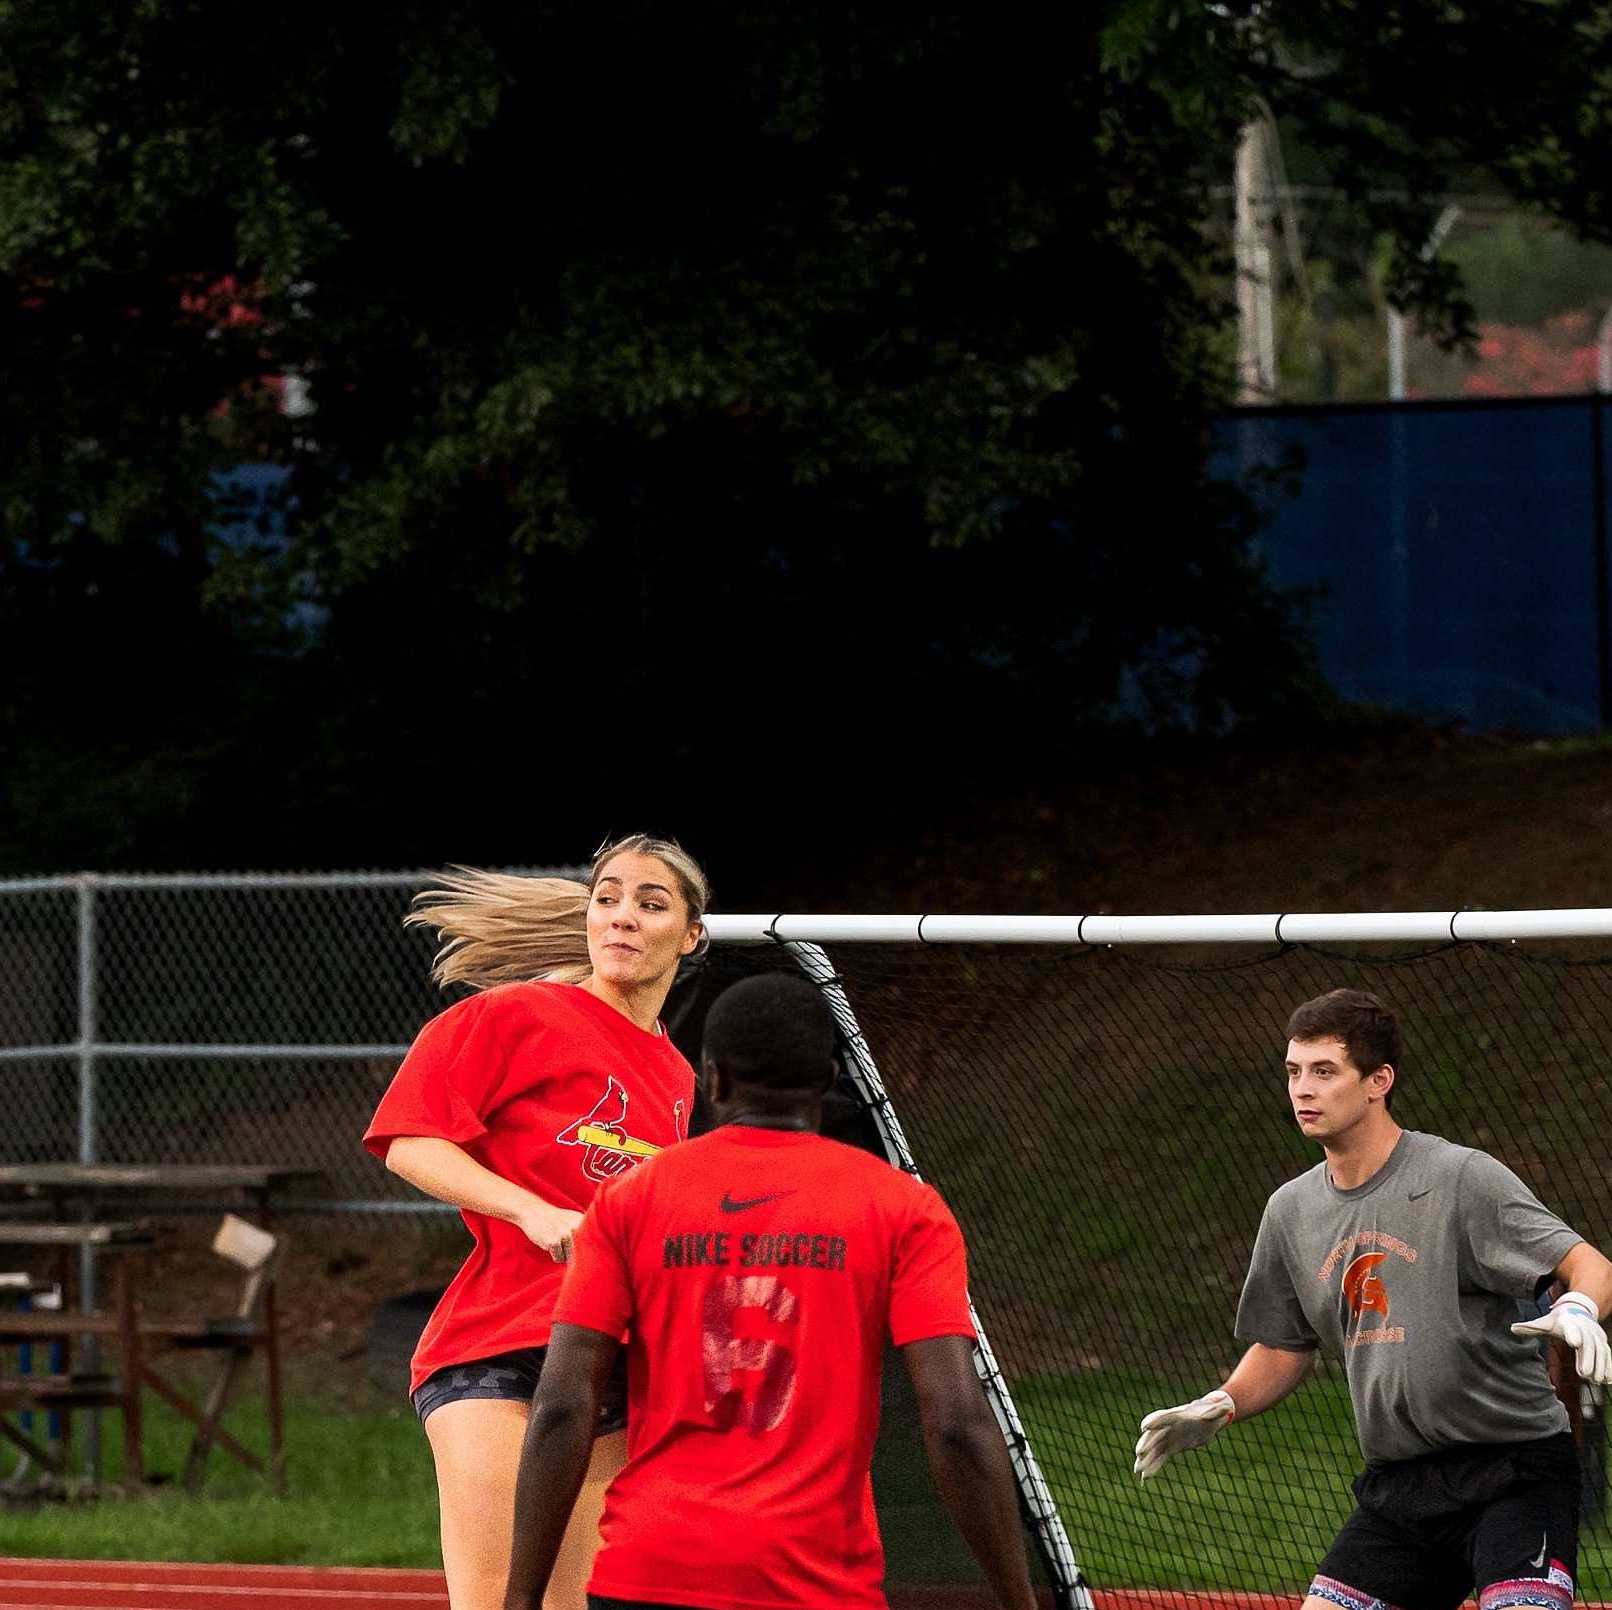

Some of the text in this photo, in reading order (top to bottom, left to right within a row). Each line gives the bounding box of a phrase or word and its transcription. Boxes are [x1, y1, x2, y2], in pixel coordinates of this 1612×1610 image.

[663, 1233, 848, 1271] NIKE SOCCER
[1318, 1230, 1418, 1283] NORTH SPRINGS
